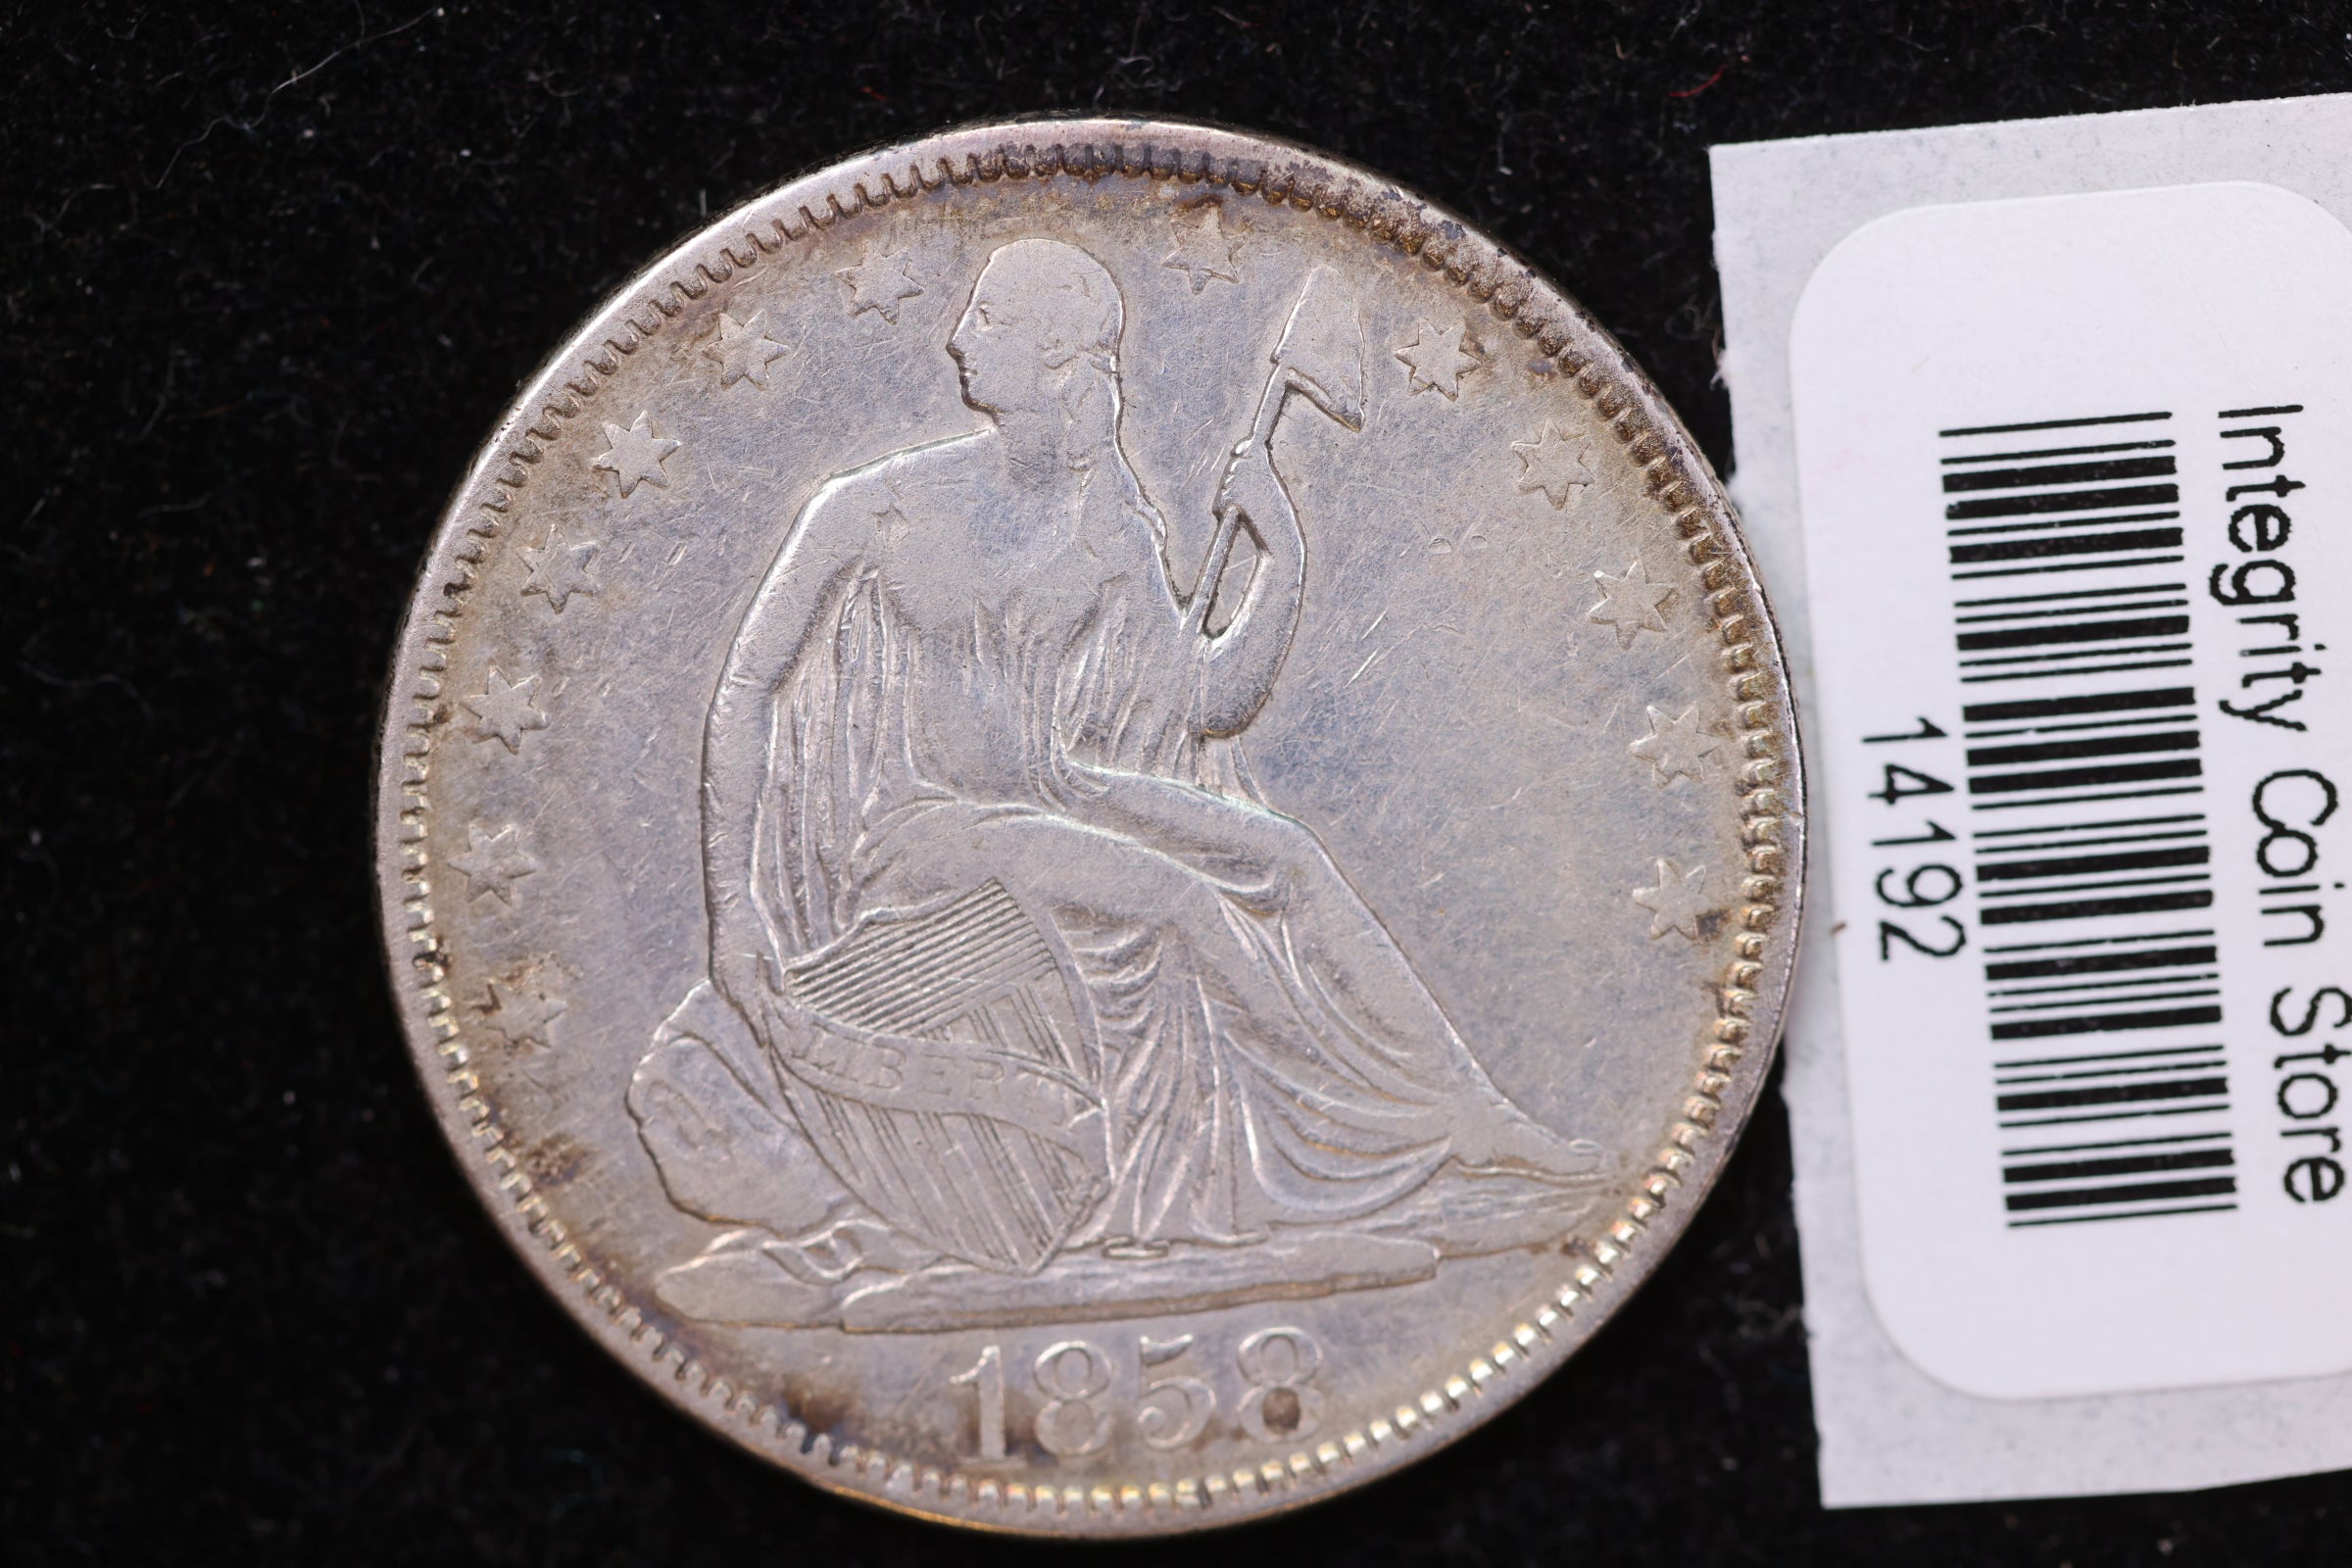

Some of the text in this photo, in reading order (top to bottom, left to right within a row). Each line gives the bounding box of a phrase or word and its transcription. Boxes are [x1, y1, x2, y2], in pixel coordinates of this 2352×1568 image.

[1864, 717, 1967, 960] 14192
[2209, 405, 2352, 1202] Integrity Coin Store
[950, 1326, 1324, 1468] 1858
